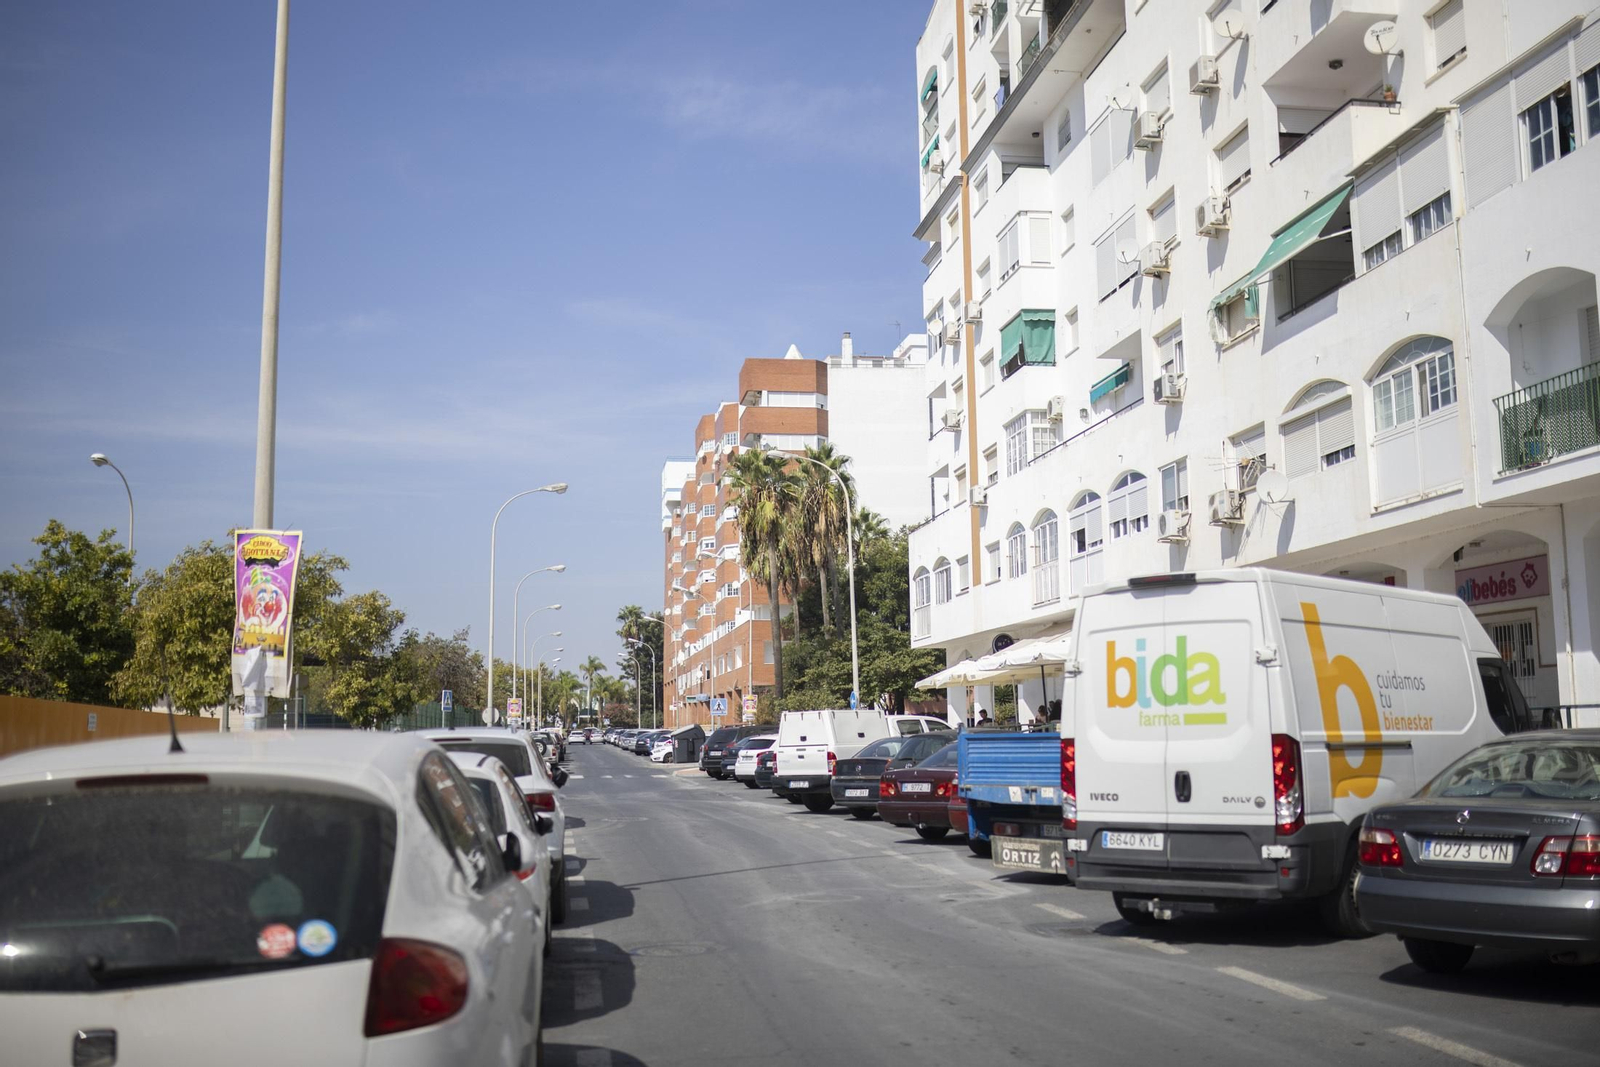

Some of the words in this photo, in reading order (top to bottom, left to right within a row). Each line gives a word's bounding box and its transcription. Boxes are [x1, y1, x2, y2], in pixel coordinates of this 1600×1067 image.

[1106, 635, 1227, 709] bida
[1376, 669, 1426, 691] cuidamos
[1379, 690, 1392, 709] tu
[1139, 711, 1181, 727] farma
[1382, 711, 1433, 731] bienestar
[1090, 793, 1119, 802] IVECO
[1222, 796, 1252, 804] DAILY
[1109, 834, 1136, 848] 6640
[1139, 835, 1161, 848] KYL
[1002, 849, 1041, 864] ORTIZ
[1433, 842, 1471, 859] 0273
[1479, 844, 1510, 861] CYN
